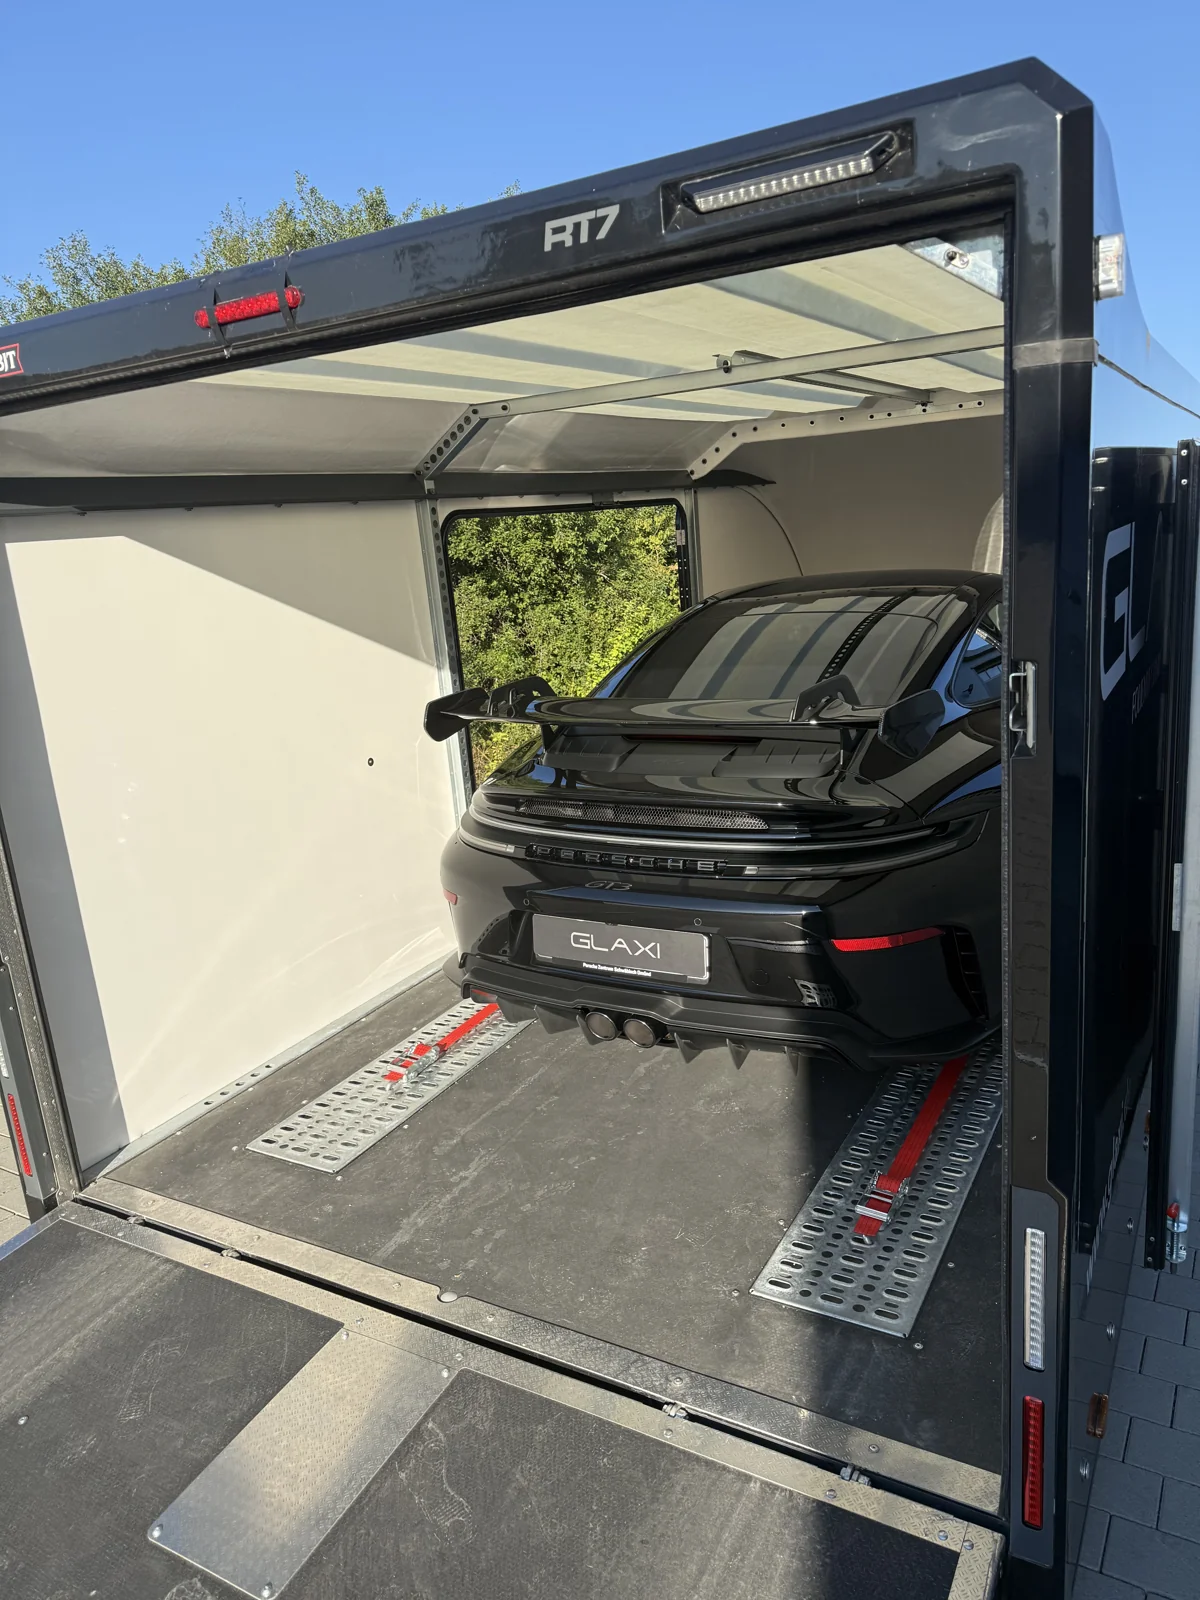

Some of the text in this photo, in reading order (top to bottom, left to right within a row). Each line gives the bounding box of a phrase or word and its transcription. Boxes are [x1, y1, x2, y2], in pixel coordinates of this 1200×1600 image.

[544, 204, 620, 252] RT7
[536, 845, 716, 872] PORSCHE
[585, 880, 633, 891] GT3
[570, 931, 661, 959] GLAXI
